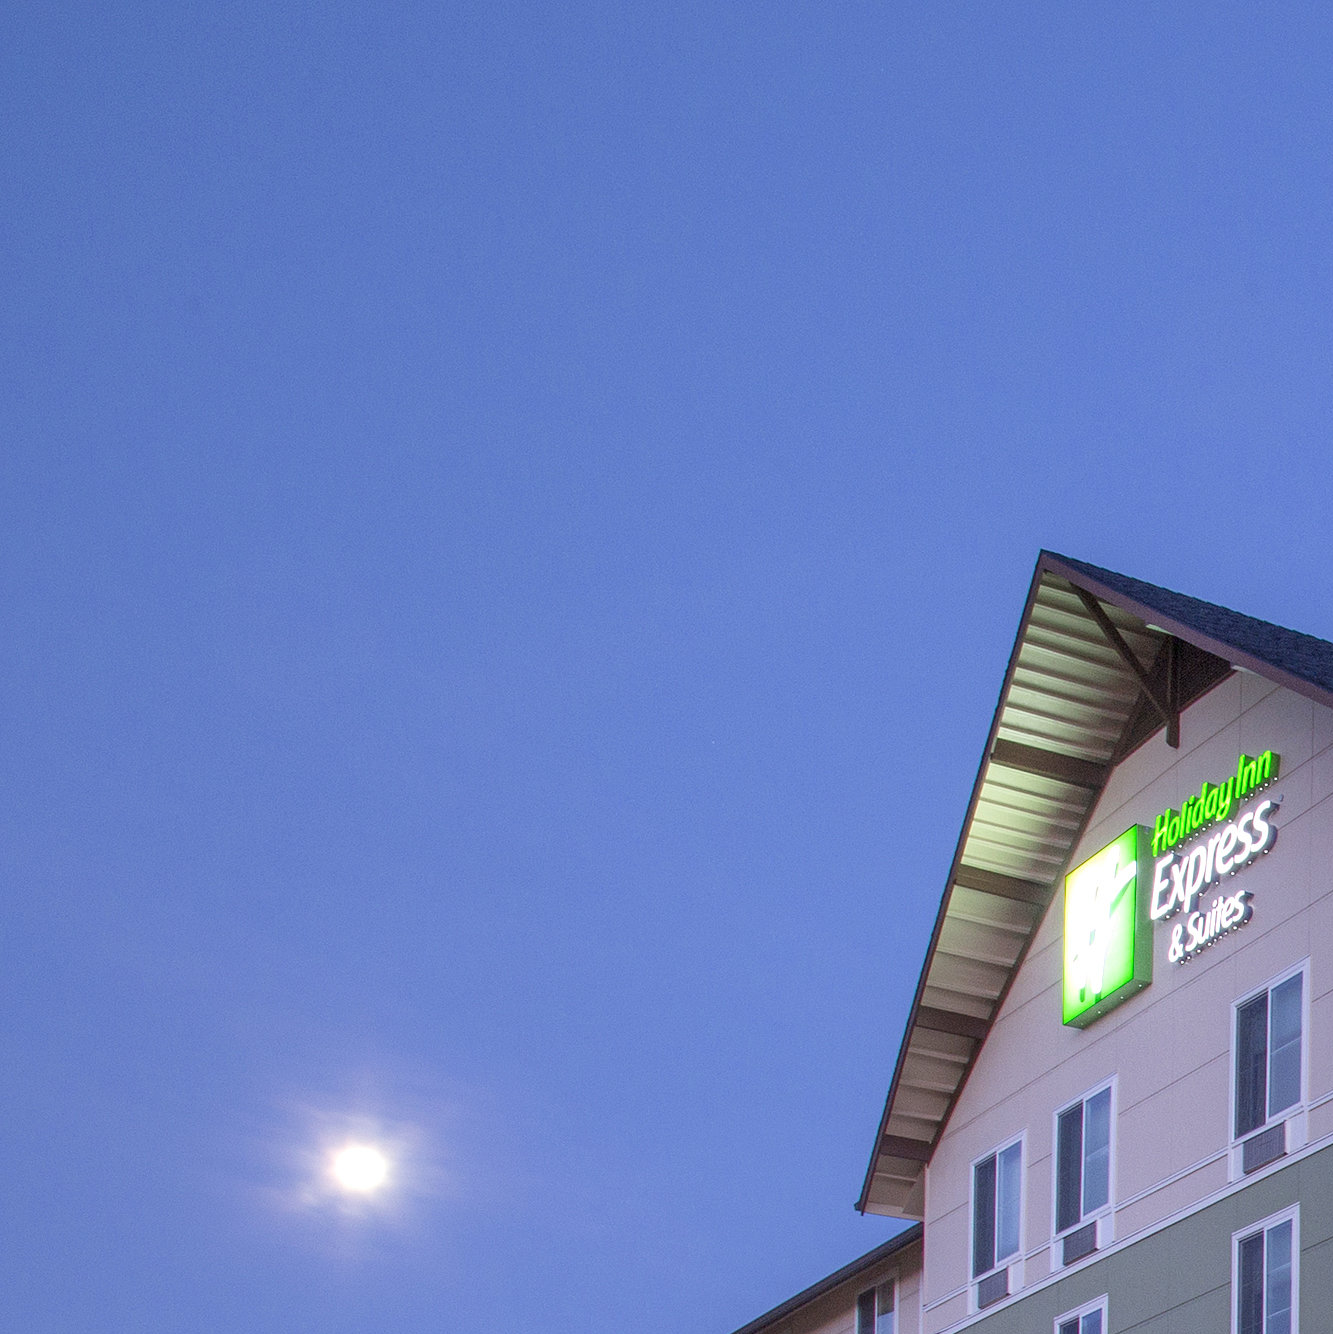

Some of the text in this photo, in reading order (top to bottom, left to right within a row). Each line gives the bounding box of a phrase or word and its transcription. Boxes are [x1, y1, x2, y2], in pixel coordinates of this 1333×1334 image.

[1151, 750, 1272, 858] Holiday Inn
[1151, 800, 1271, 920] Express
[1168, 890, 1246, 963] & Suites
